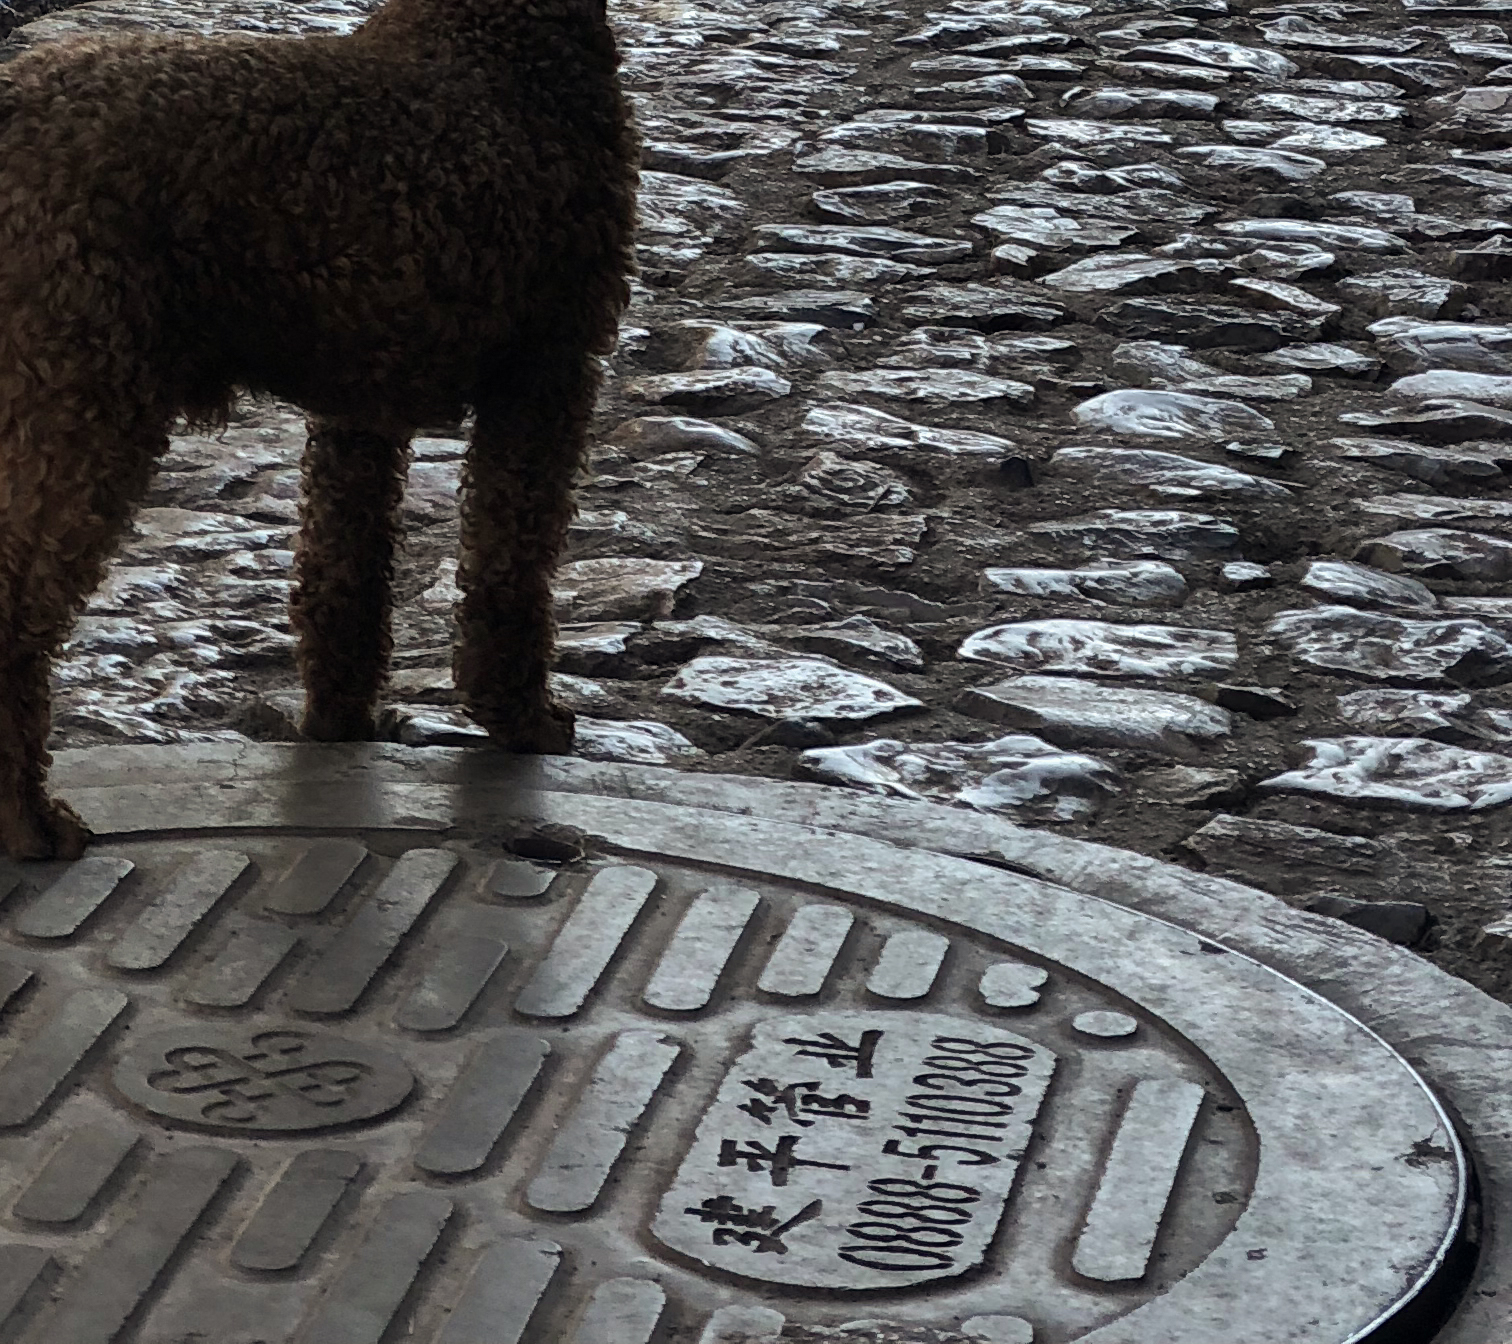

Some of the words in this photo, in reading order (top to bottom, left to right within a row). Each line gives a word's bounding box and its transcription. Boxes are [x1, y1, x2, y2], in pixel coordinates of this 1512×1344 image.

[683, 1028, 885, 1255] 建平管业
[836, 1035, 1037, 1272] 0888-5110388
